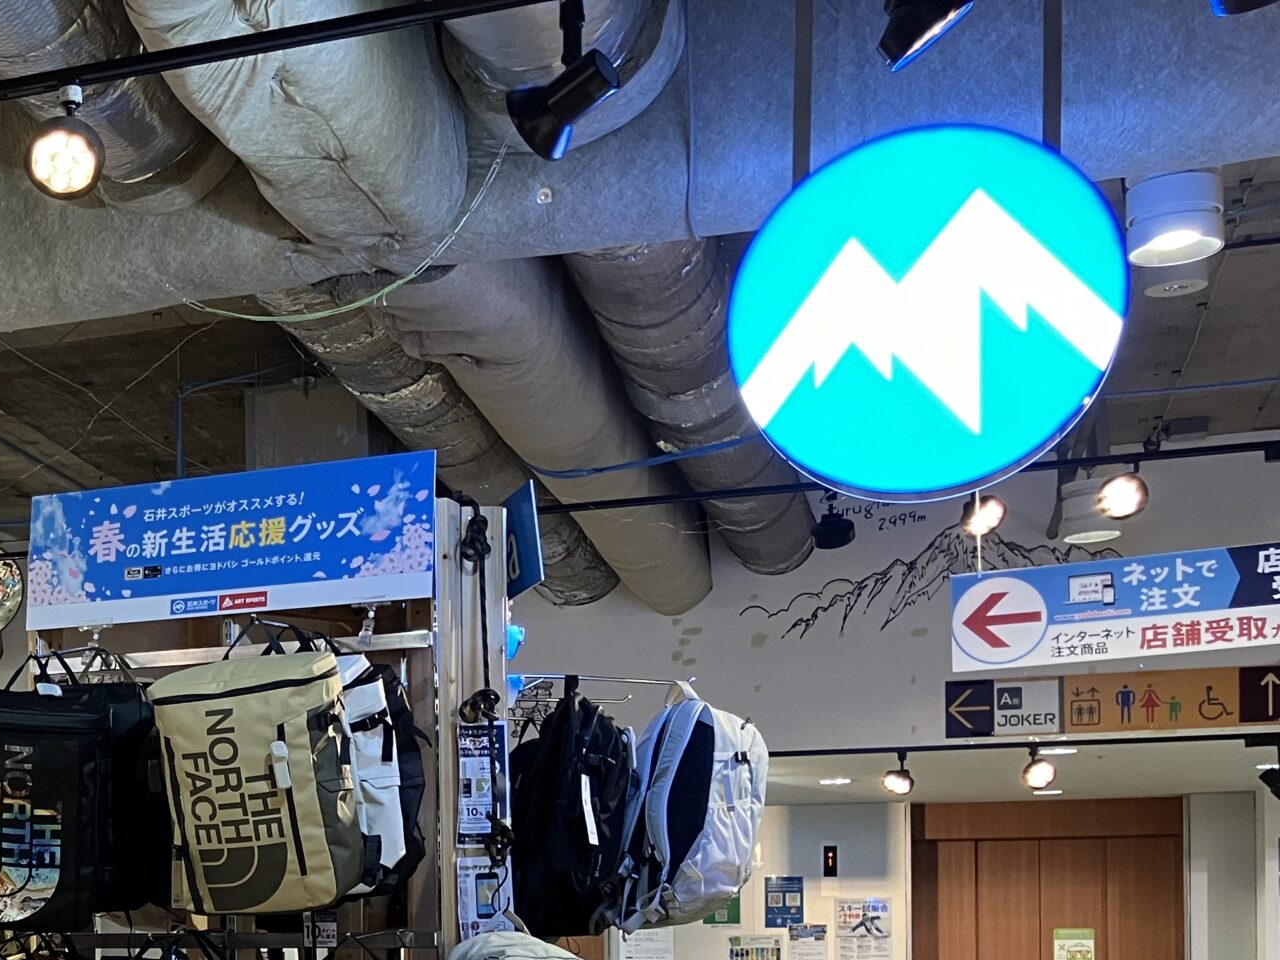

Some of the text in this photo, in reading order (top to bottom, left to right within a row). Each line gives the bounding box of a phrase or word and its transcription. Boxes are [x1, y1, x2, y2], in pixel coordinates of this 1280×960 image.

[88, 507, 365, 564] 春の新生活応援グッズ
[1122, 557, 1218, 586] ネットで
[1140, 583, 1201, 612] 注文
[1050, 627, 1136, 645] インターネット
[1050, 641, 1109, 658] 注文商品
[997, 713, 1056, 727] JOKER
[2, 744, 33, 864] NORTH
[181, 752, 223, 845] FACE
[205, 708, 253, 844] NORTH
[245, 764, 285, 842] THE
[32, 800, 62, 866] THE
